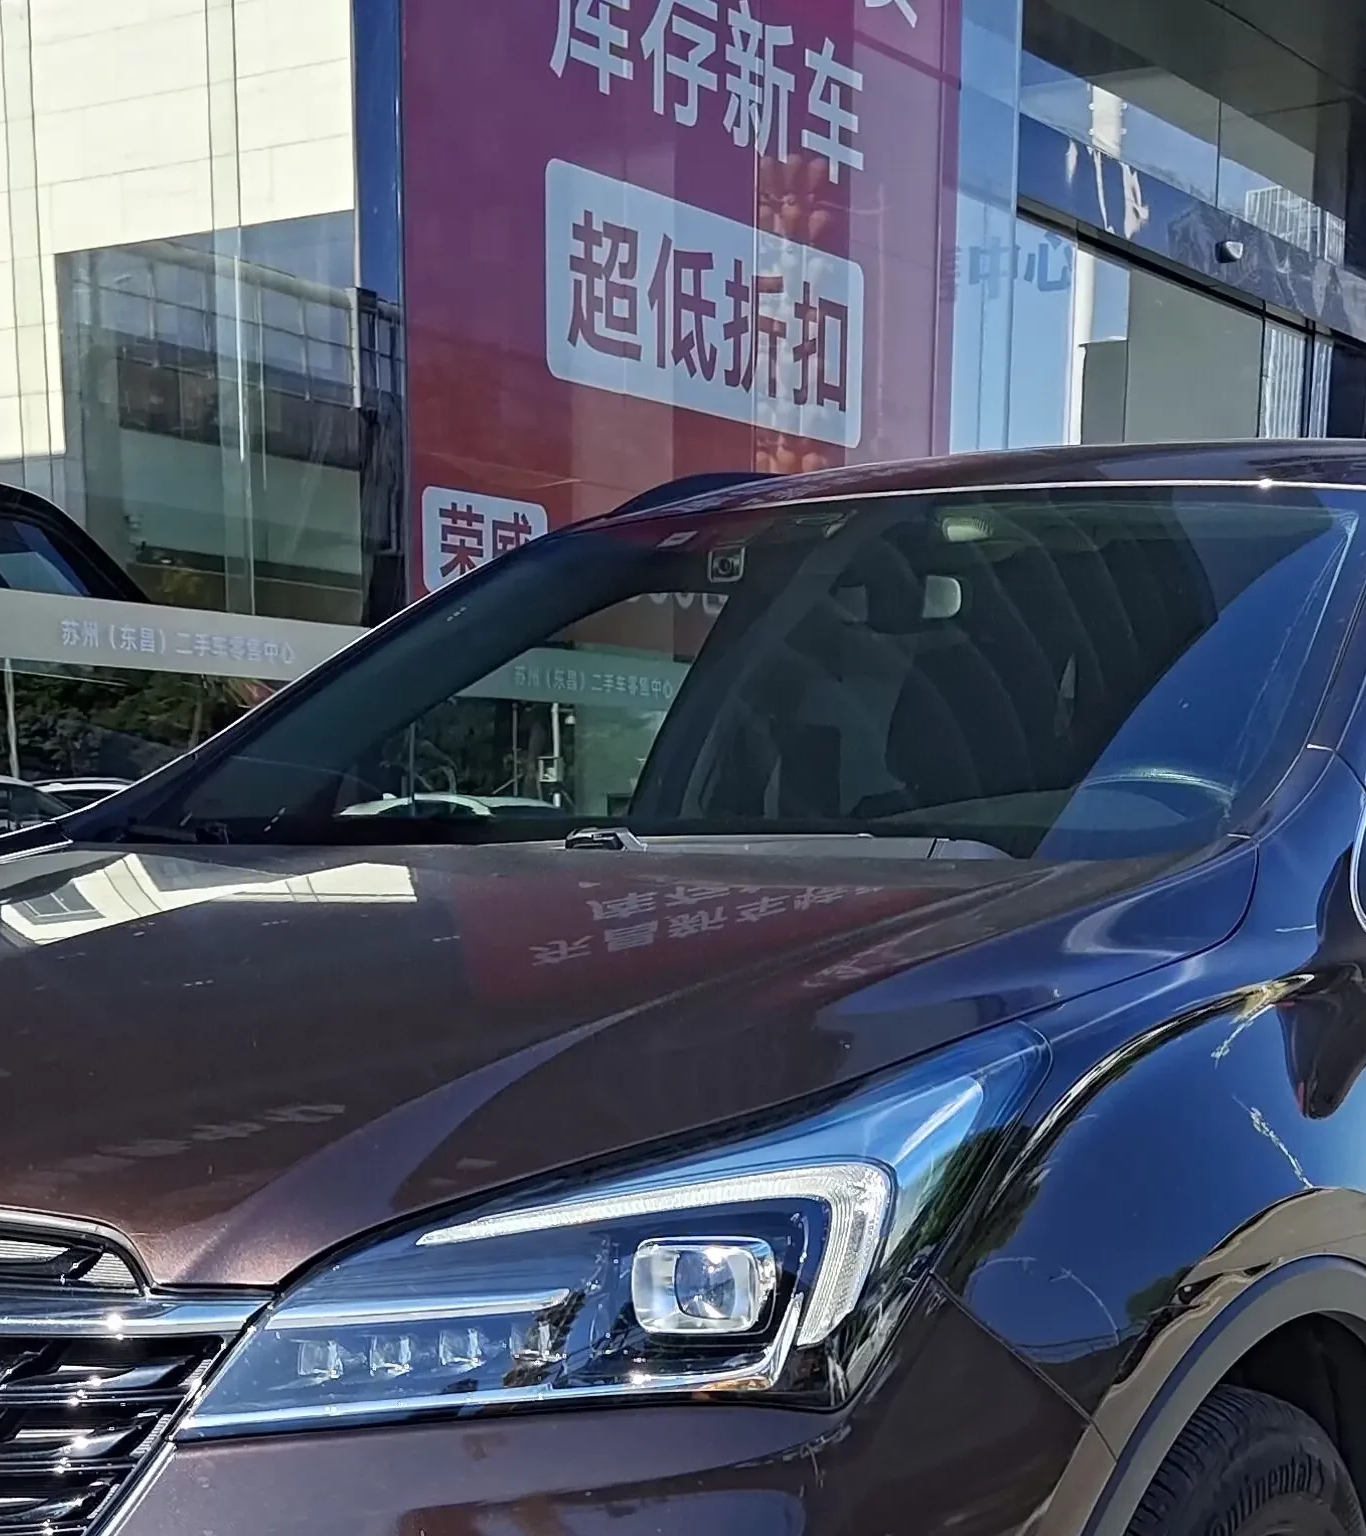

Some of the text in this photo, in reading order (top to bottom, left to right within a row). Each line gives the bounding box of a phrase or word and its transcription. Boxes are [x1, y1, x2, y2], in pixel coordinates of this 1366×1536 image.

[549, 0, 864, 185] 库存新车
[566, 210, 849, 414] 超低折扣
